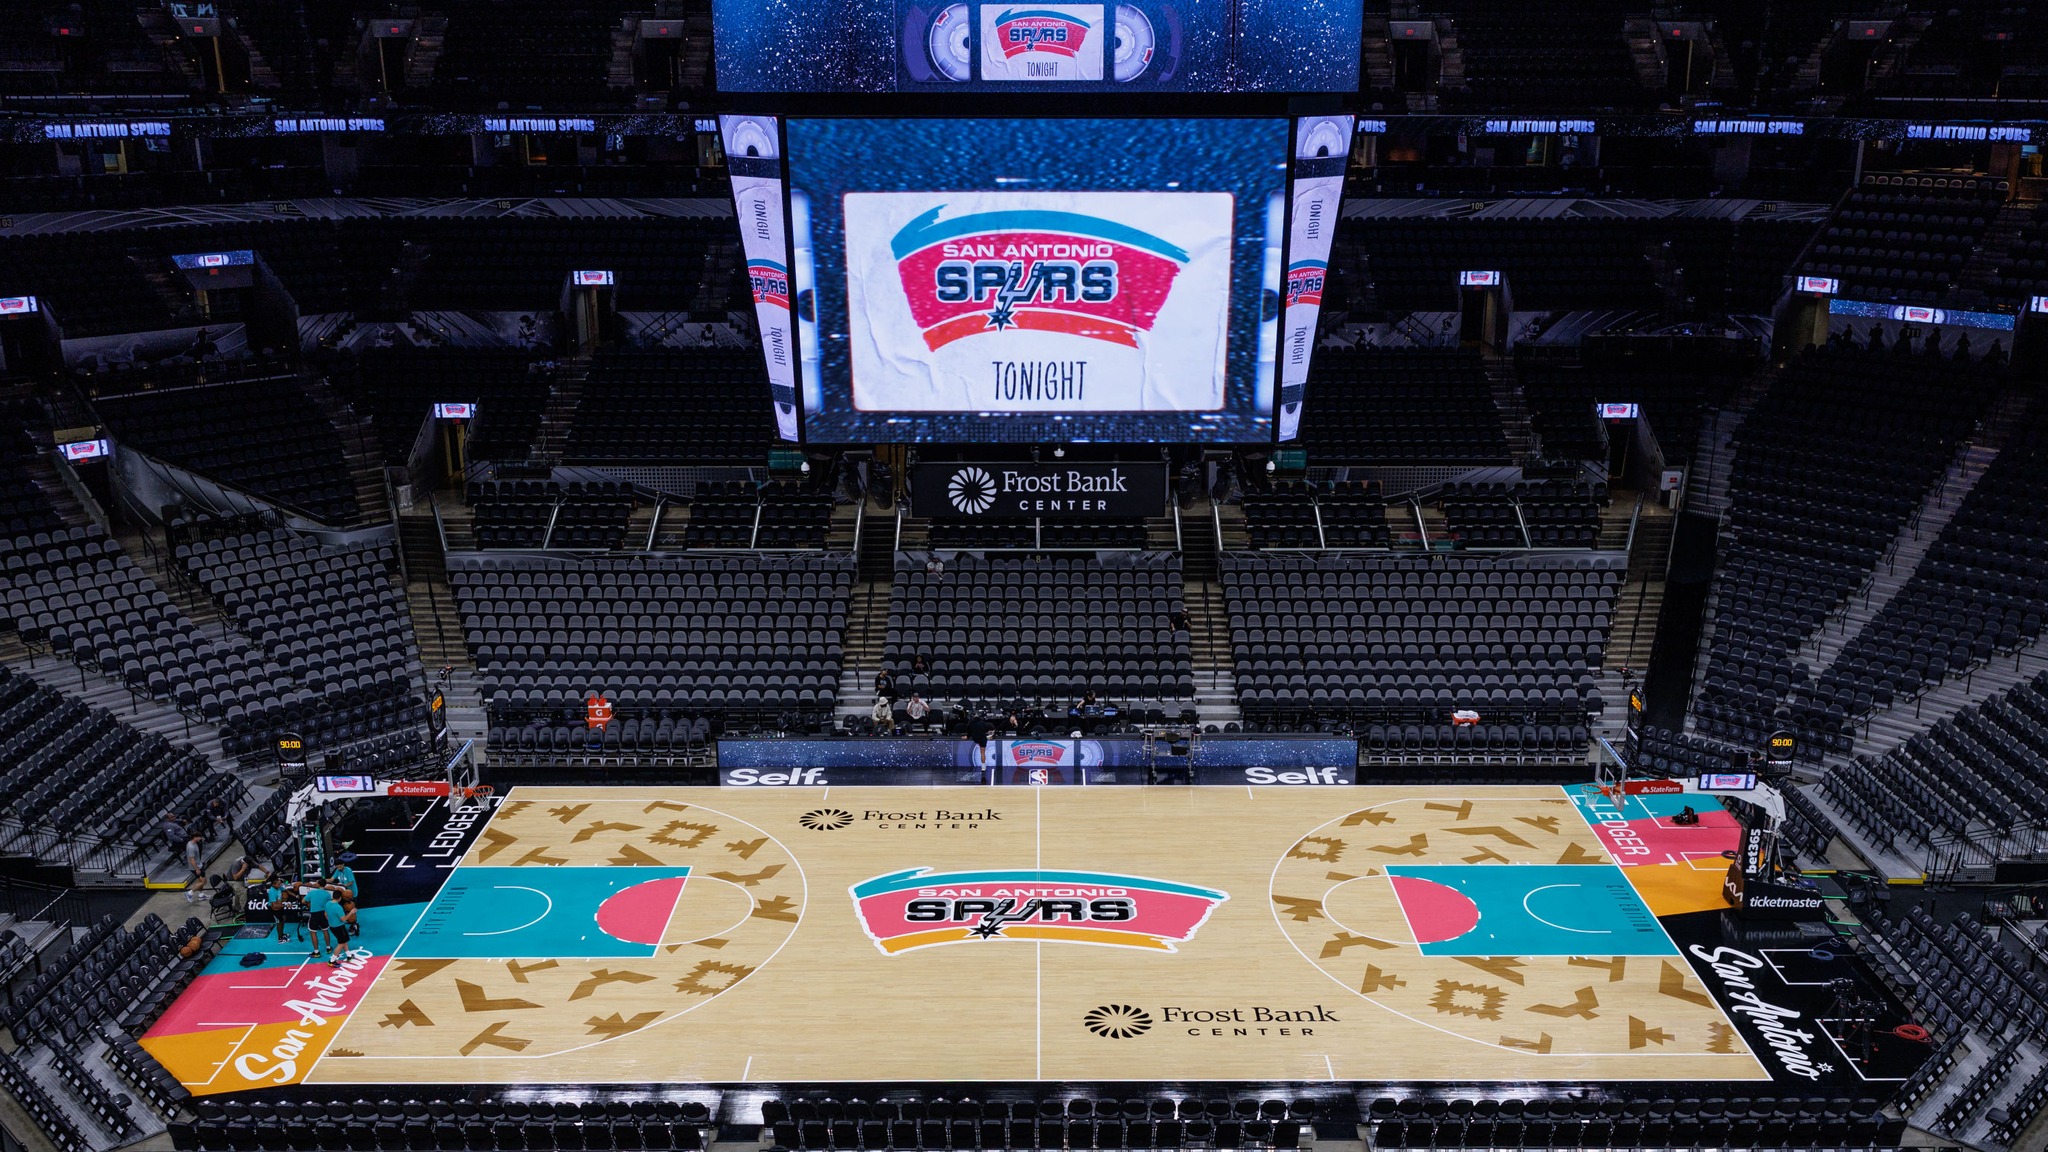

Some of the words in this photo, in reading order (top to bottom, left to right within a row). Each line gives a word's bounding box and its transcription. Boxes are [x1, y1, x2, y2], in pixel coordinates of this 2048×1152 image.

[1009, 28, 1068, 42] SPURS
[1027, 62, 1058, 77] TONIGHT
[45, 124, 72, 138] SAN
[74, 123, 128, 138] ANTONIO
[130, 122, 171, 136] SPURS
[275, 119, 298, 132] SAN
[300, 119, 346, 132] ANTONIO
[349, 118, 385, 131] SPURS
[484, 119, 508, 132] SAN
[509, 119, 556, 132] ANTONIO
[559, 119, 595, 132] SPURS
[695, 119, 717, 132] SAN
[1358, 120, 1387, 133] PURS
[1485, 120, 1508, 133] SAN
[1510, 120, 1556, 133] ANTONIO
[1559, 120, 1595, 133] SPURS
[1694, 121, 1717, 133] SAN
[1718, 121, 1766, 134] ANTONIO
[1768, 122, 1804, 135] SPURS
[1907, 125, 1933, 138] SAN
[1933, 126, 1987, 140] ANTONIO
[1989, 127, 2031, 141] SPURS
[1471, 202, 1484, 210] 109
[0, 217, 12, 227] 03
[753, 199, 770, 241] TONIGHT
[1307, 199, 1323, 240] TONIGHT
[942, 244, 1003, 258] SAN
[1006, 244, 1113, 258] ANTONIO
[935, 260, 1119, 305] SPURS
[770, 326, 786, 367] TONIGHT
[1291, 326, 1307, 365] TONIGHT
[991, 361, 1088, 401] TONIGHT
[1002, 471, 1062, 492] Frost
[1066, 468, 1128, 492] Bank
[1019, 500, 1107, 511] CENTER
[279, 740, 301, 749] 90:00
[1772, 738, 1793, 747] 90:00
[1019, 749, 1053, 757] SPURS
[727, 767, 828, 786] Self.
[1245, 766, 1349, 785] Self.
[862, 810, 928, 821] Frost
[935, 808, 1003, 821] Bank
[422, 804, 482, 857] LEDGER
[1590, 803, 1650, 856] LEDGER
[1746, 828, 1762, 874] bet365
[918, 889, 986, 897] SAN
[991, 888, 1128, 897] ANTONIO
[1606, 885, 1632, 900] CITY
[1619, 904, 1655, 933] EDITION
[1749, 896, 1823, 908] ticketmaster
[419, 918, 446, 934] CITY
[433, 887, 469, 914] EDITION
[905, 898, 1137, 924] SPURS
[235, 1029, 314, 1083] San
[282, 946, 373, 1027] Antonio
[1160, 1007, 1245, 1022] Frost
[1251, 1005, 1341, 1022] Bank
[1689, 943, 1763, 989] San
[1728, 991, 1820, 1081] Antonio
[1187, 1028, 1314, 1036] CENTER
